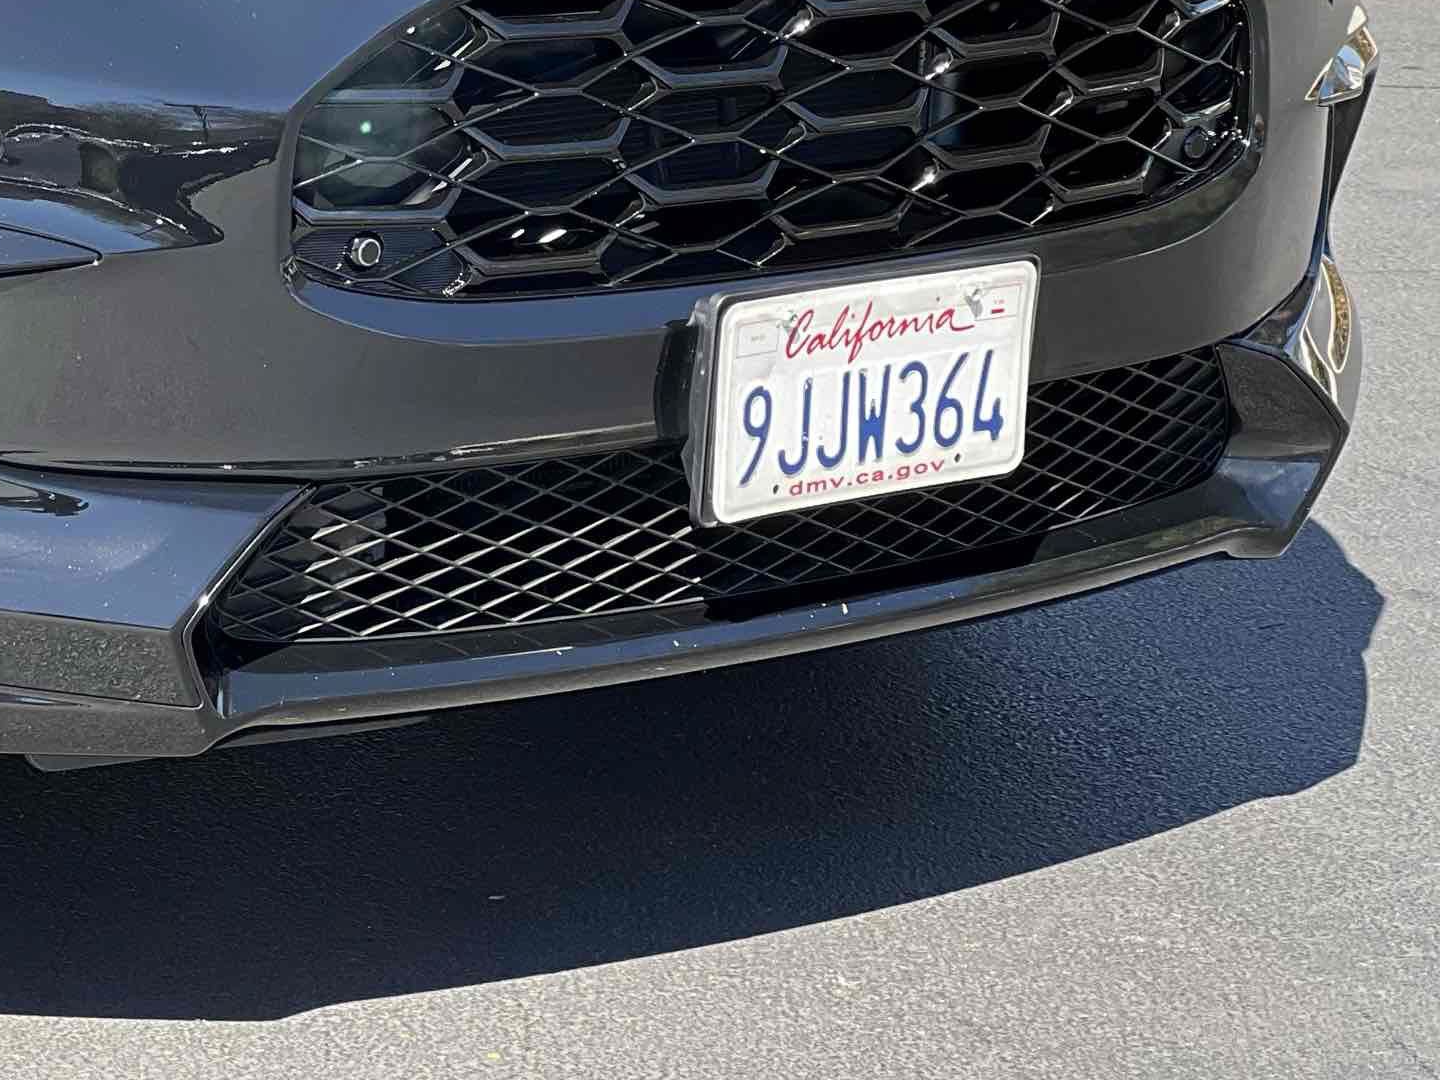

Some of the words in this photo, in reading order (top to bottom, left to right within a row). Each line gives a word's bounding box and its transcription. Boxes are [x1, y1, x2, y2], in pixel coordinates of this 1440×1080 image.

[785, 300, 975, 364] California
[738, 348, 1005, 487] 9JJW364
[789, 457, 945, 497] dmv.ca.gov
